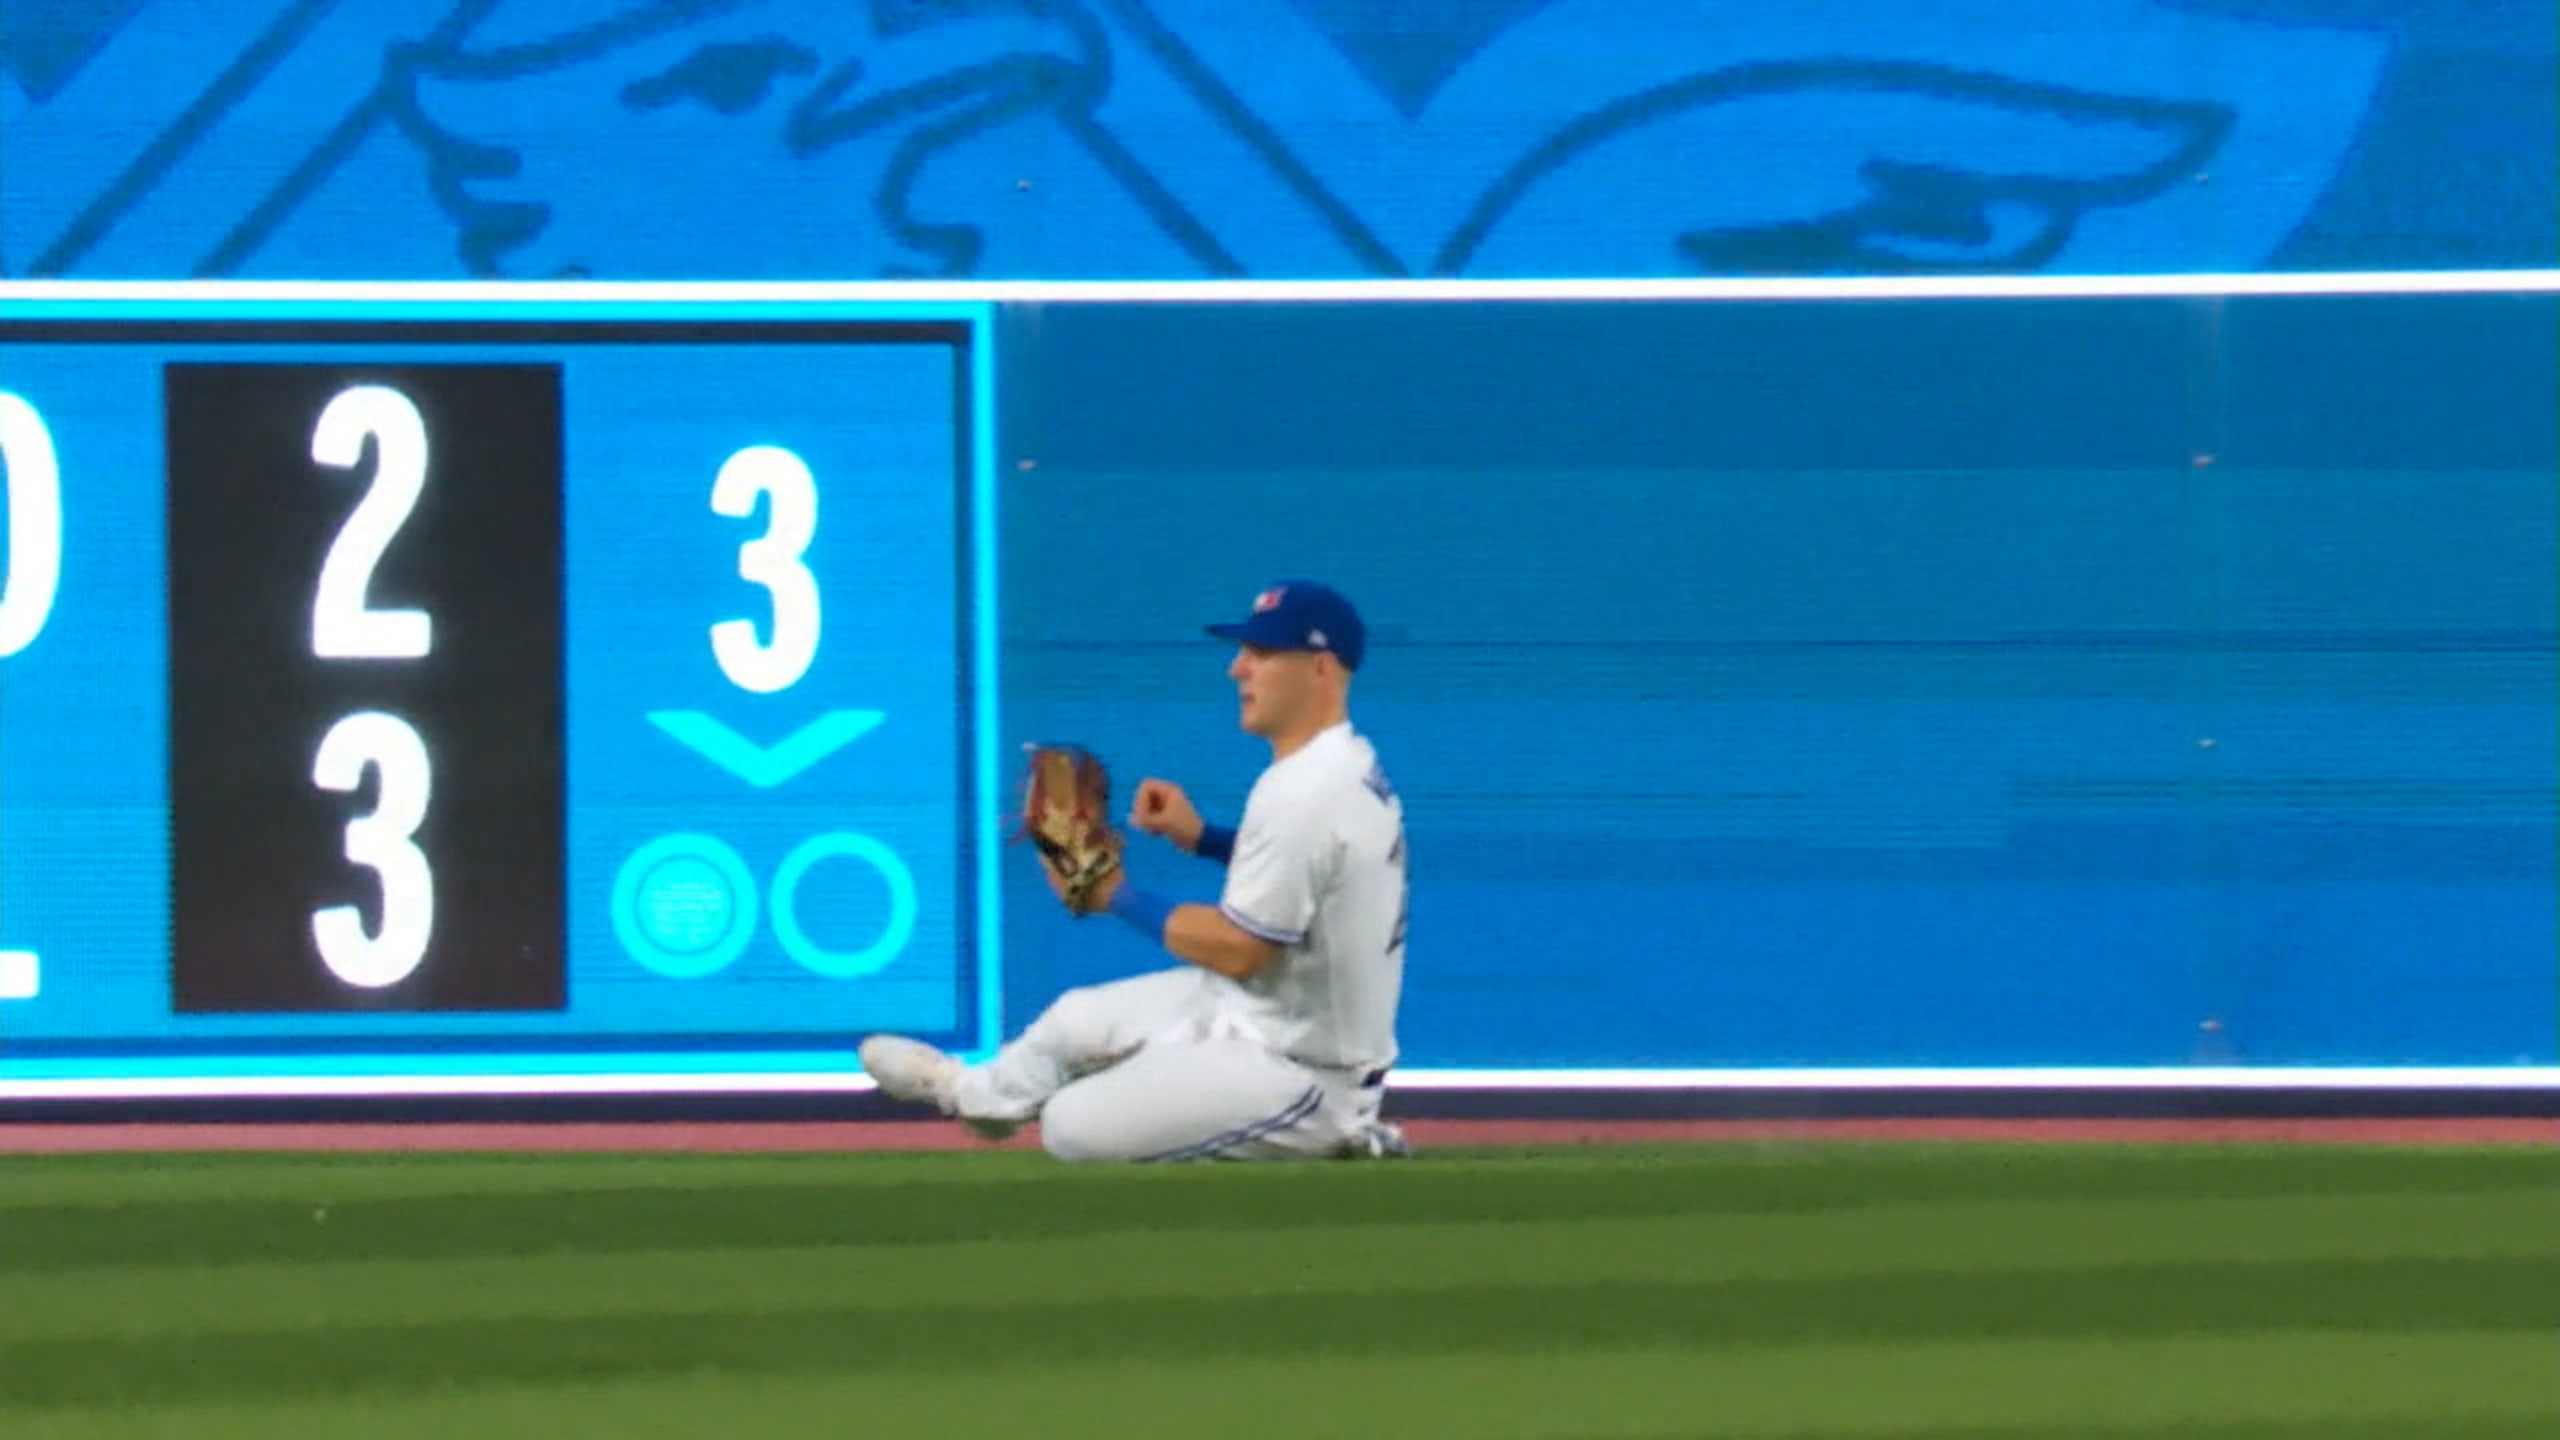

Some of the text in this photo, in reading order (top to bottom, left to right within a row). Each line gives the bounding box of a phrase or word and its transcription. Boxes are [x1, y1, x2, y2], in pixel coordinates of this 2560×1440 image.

[311, 385, 432, 660] 2
[710, 445, 821, 693] 3
[311, 711, 434, 989] 3
